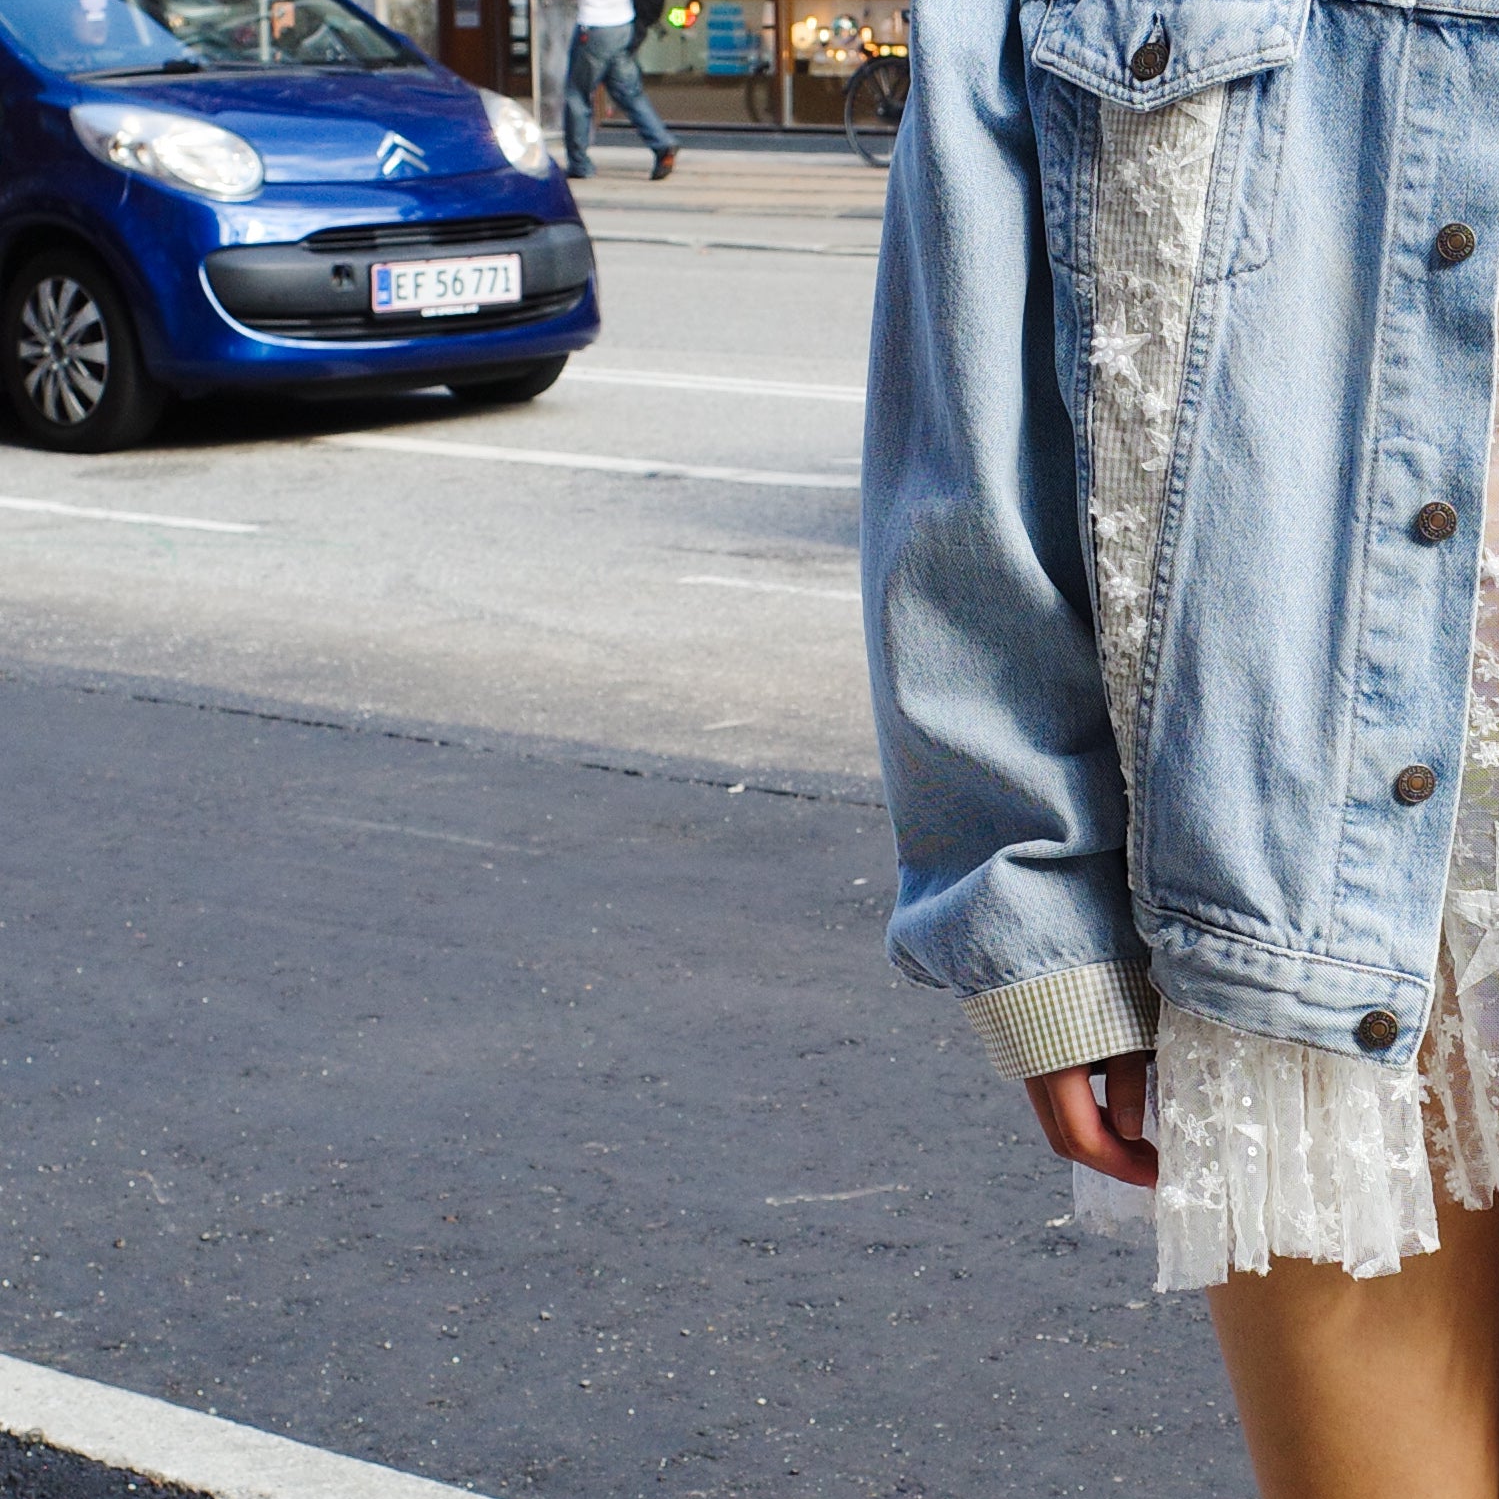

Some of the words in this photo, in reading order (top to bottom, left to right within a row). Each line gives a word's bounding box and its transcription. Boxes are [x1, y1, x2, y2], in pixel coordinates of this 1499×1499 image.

[396, 272, 425, 300] EF
[436, 269, 464, 298] 56
[472, 267, 511, 294] 771
